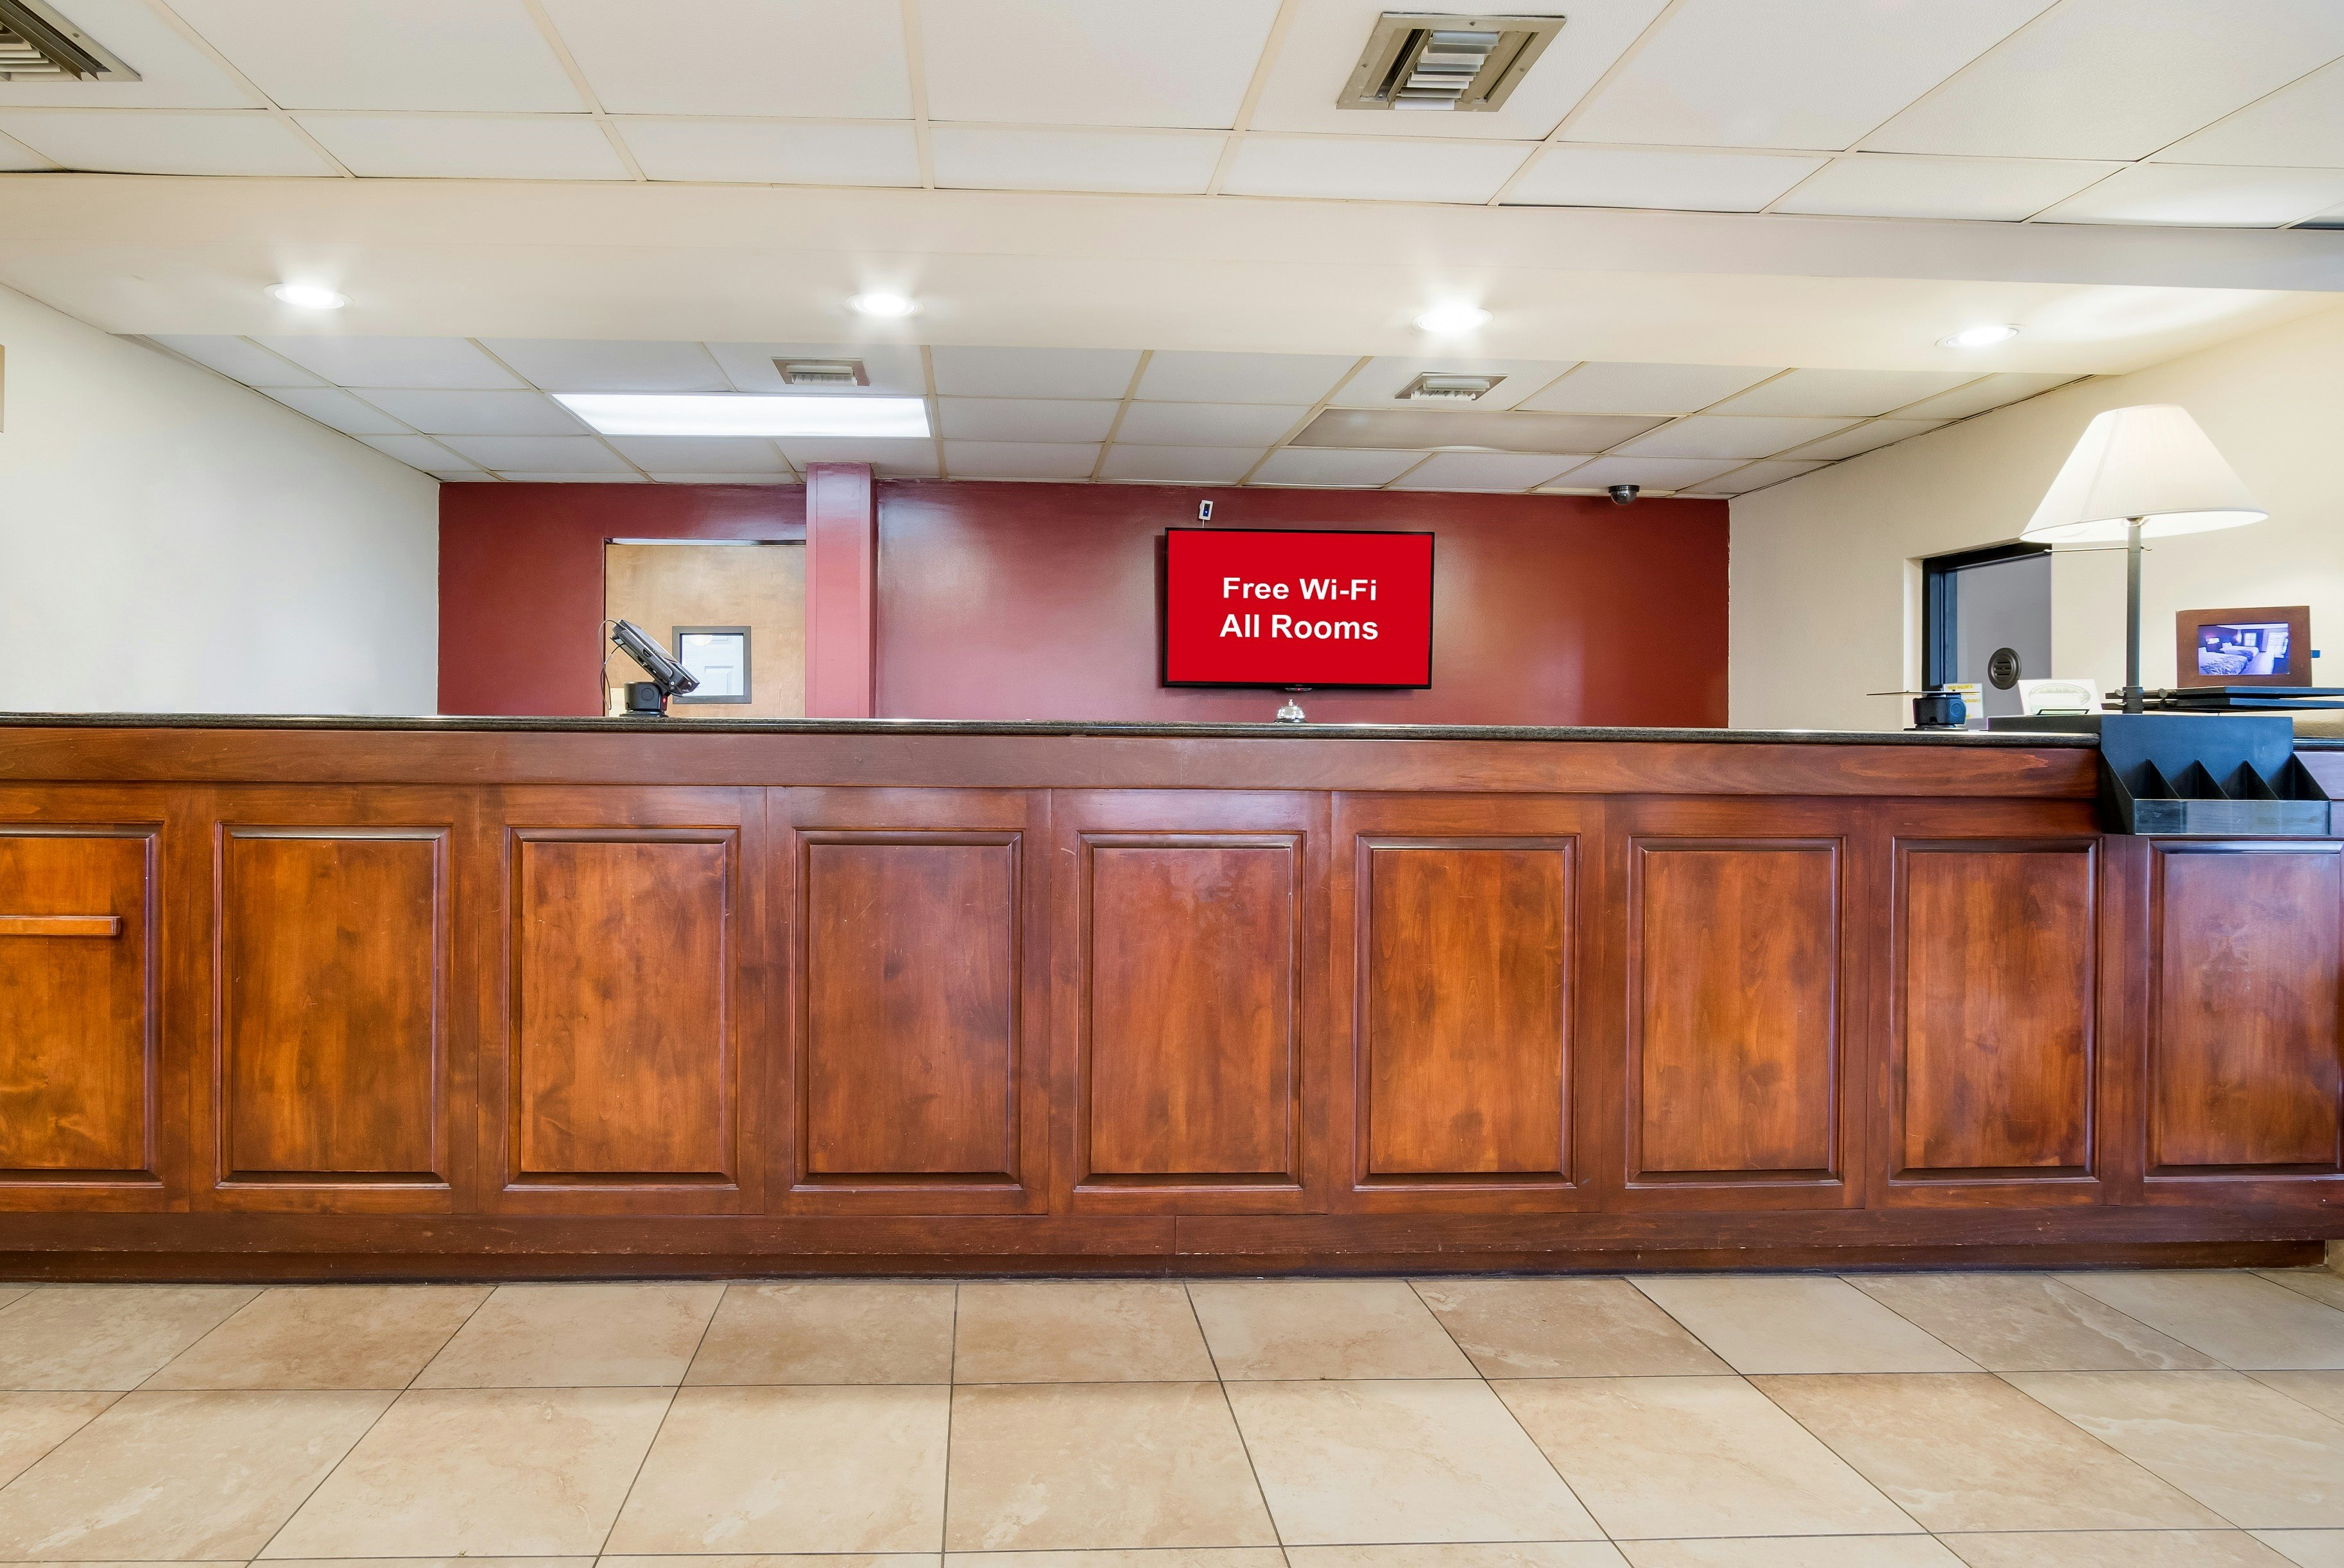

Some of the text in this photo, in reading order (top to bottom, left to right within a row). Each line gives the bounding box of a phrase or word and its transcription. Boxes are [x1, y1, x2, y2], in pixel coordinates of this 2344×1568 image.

[1223, 577, 1377, 601] Free Wi-Fi
[1219, 614, 1378, 640] All Rooms
